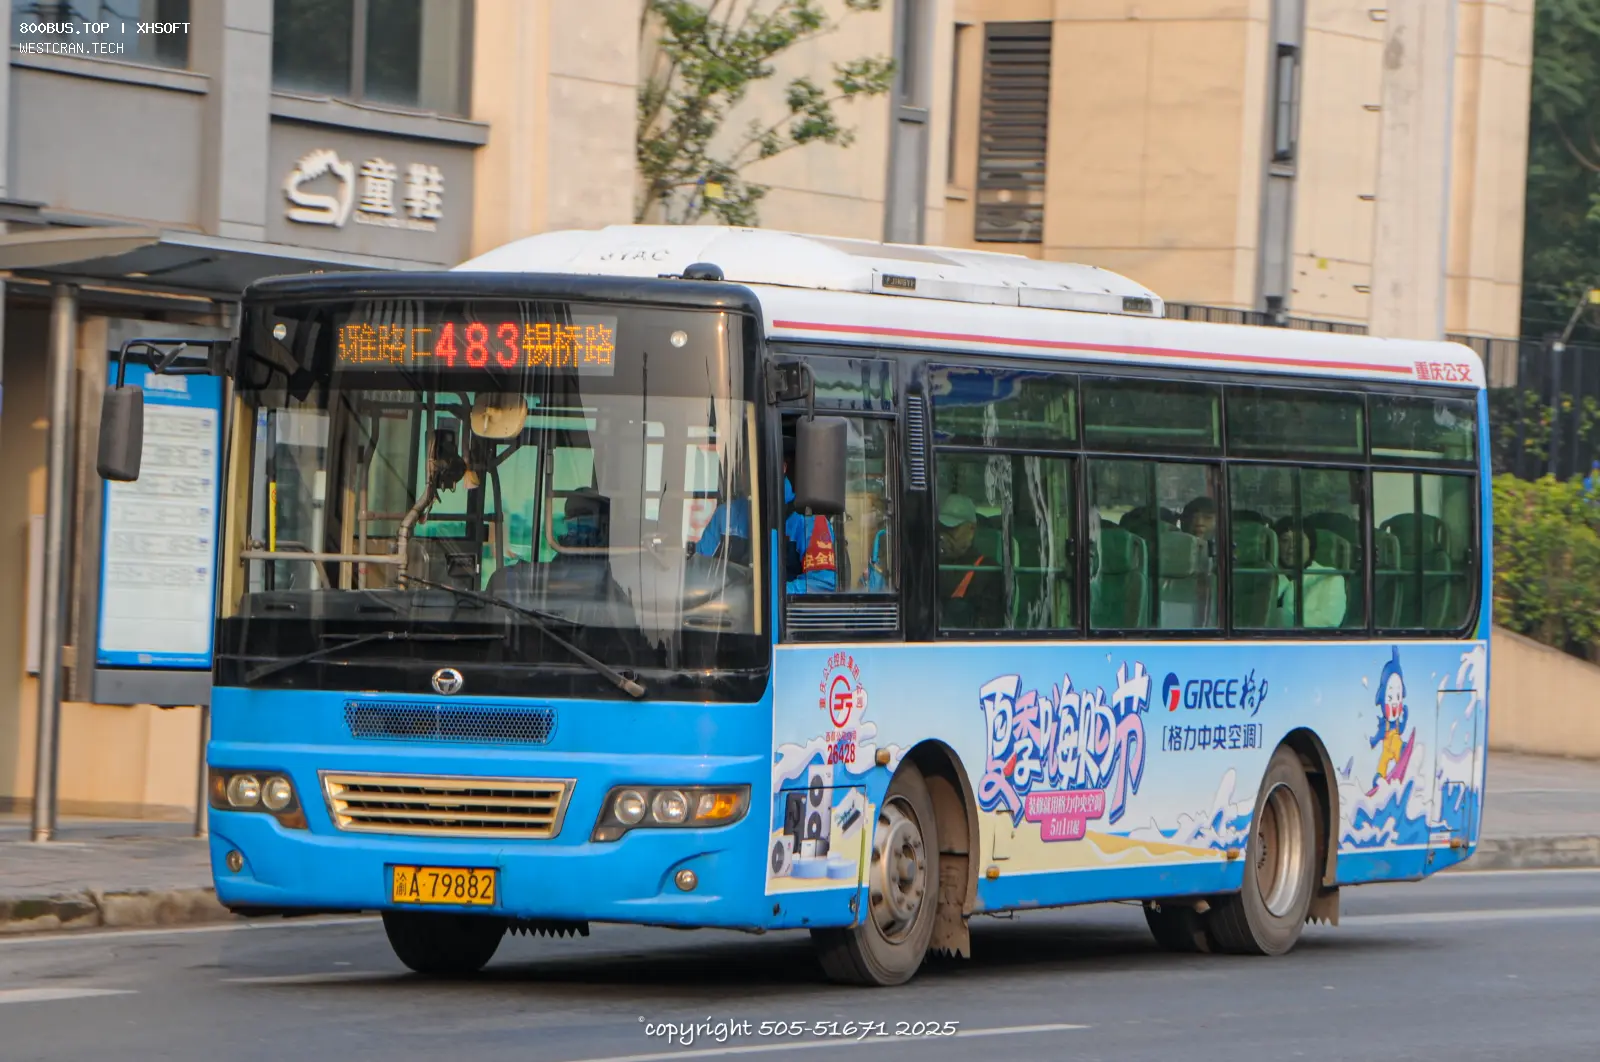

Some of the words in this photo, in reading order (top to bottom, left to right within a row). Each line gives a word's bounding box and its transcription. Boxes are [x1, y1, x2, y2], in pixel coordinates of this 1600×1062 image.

[360, 157, 444, 219] 童鞋
[434, 321, 520, 368] 483
[1414, 361, 1473, 382] 重庆公交
[1184, 679, 1239, 709] GREE
[827, 743, 856, 765] 26428
